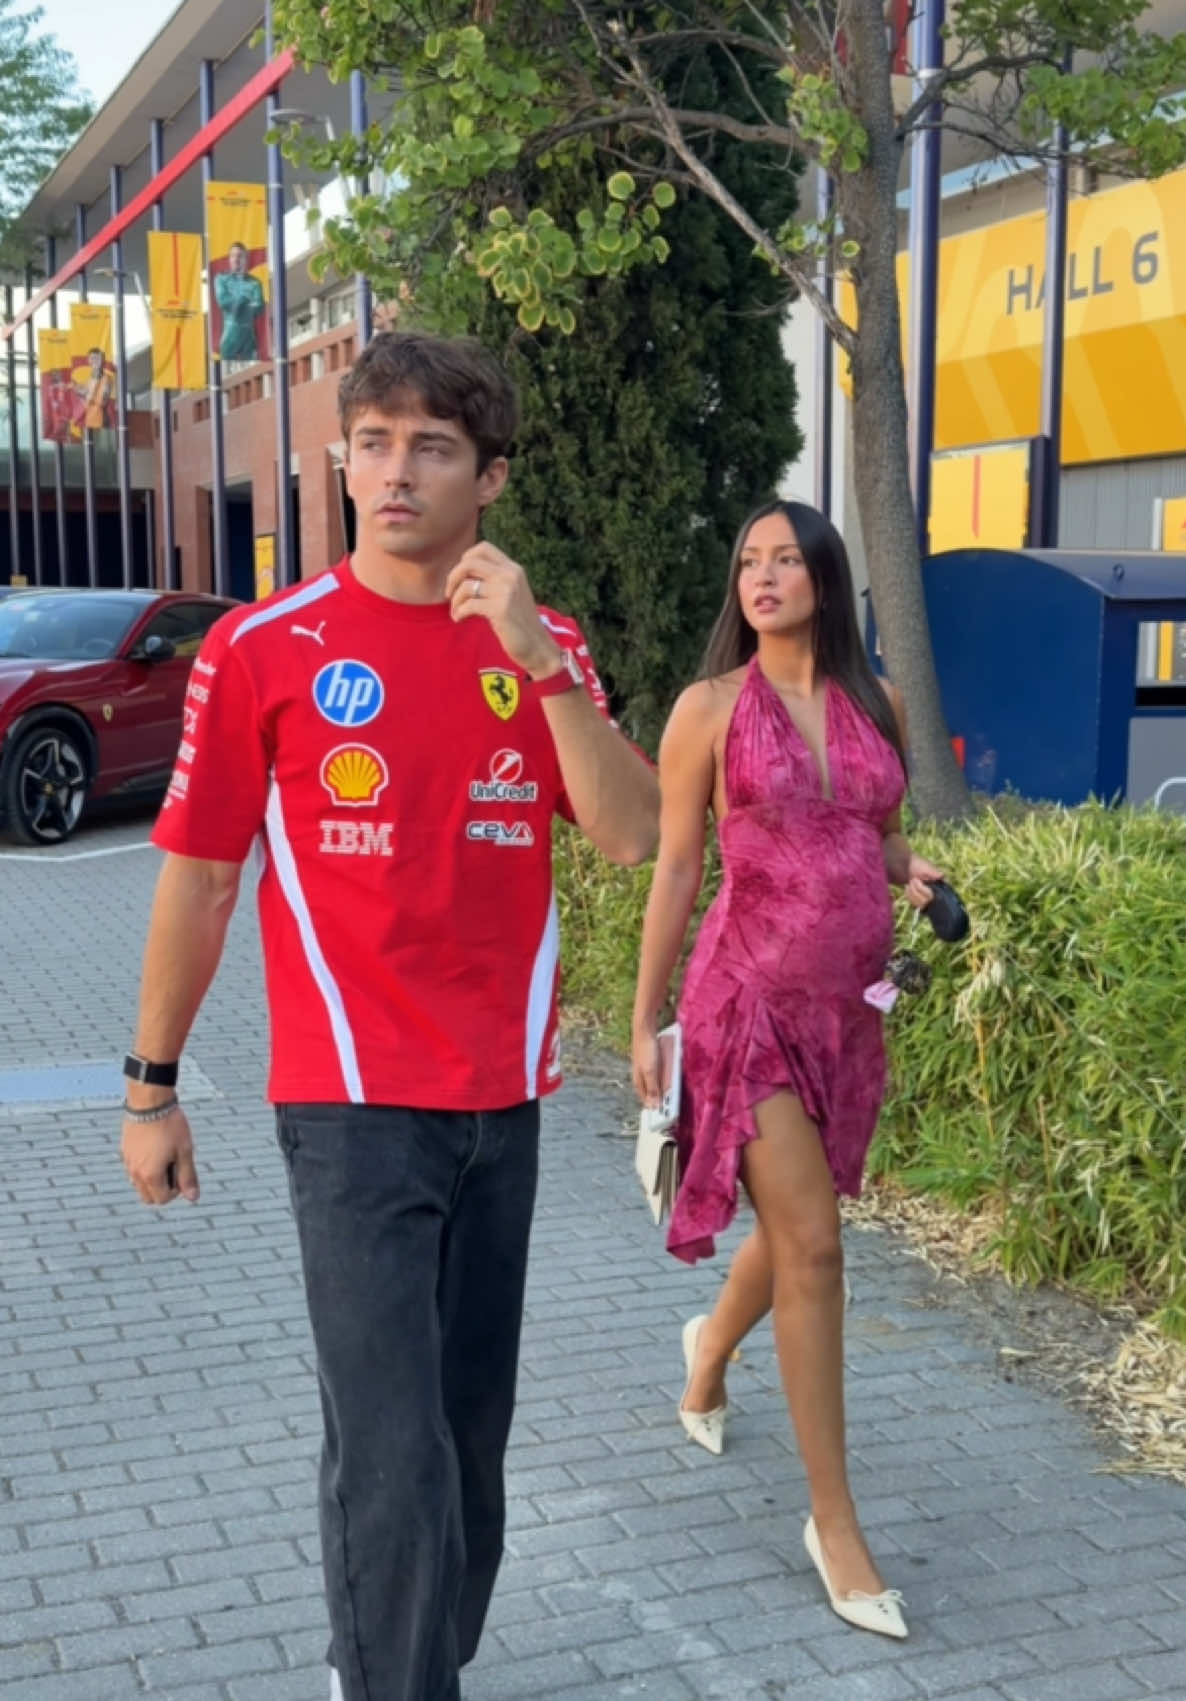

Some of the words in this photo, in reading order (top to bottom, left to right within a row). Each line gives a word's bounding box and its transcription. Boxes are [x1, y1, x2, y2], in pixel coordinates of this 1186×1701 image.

[1006, 245, 1114, 316] HLL
[1131, 230, 1159, 285] 6
[323, 662, 375, 725] hp
[470, 780, 537, 801] UniCredit
[319, 820, 394, 857] IBM
